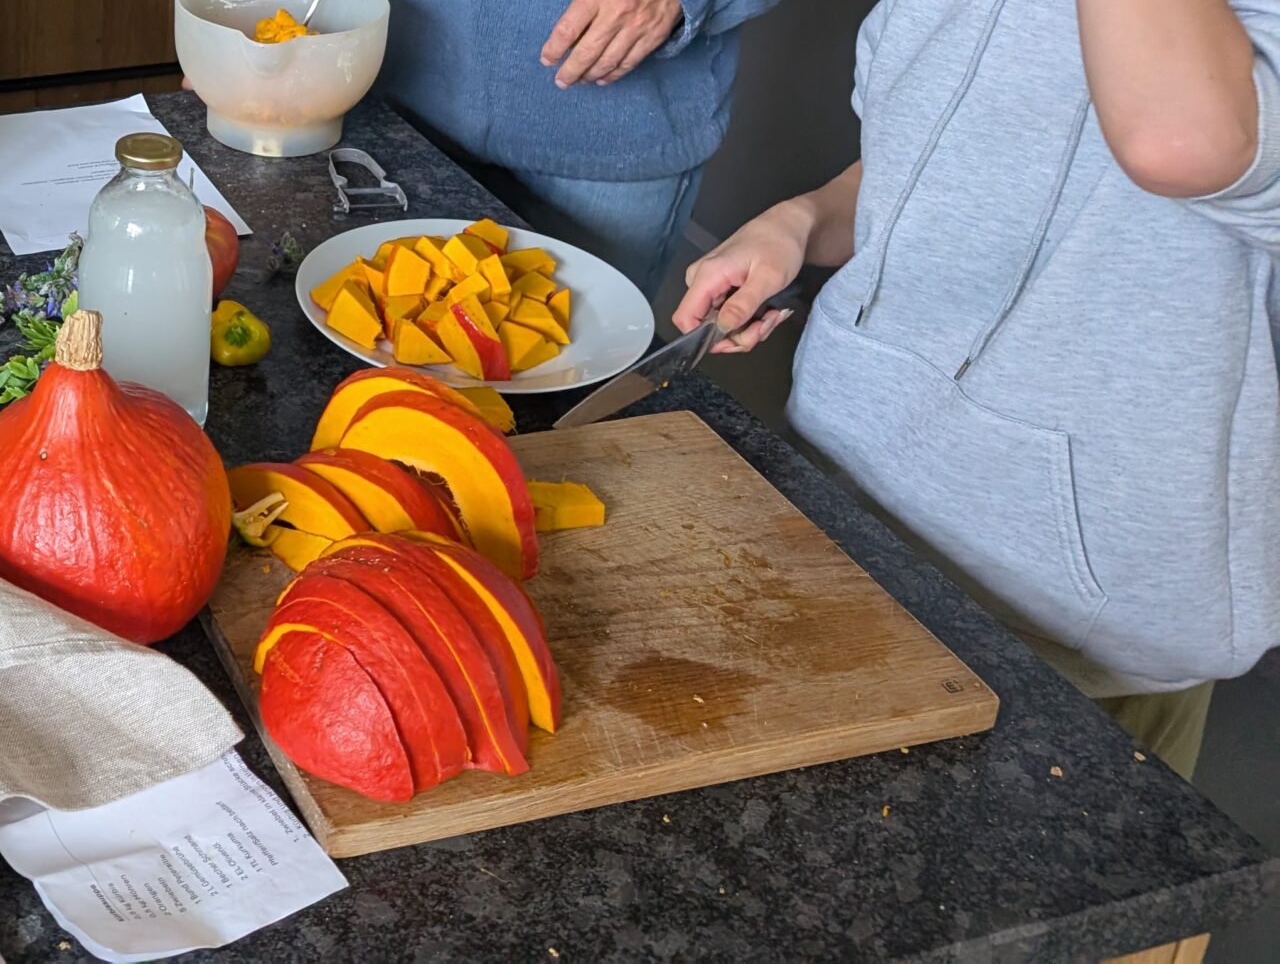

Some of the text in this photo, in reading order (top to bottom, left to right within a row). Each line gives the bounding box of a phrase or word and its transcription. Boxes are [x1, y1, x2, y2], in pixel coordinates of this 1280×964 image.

[232, 772, 252, 791] Stücke
[215, 801, 236, 817] bedarf
[264, 802, 273, 810] in
[233, 815, 249, 831] nach
[268, 809, 294, 835] Zwiebel
[183, 834, 212, 863] Schmand
[212, 842, 237, 867] Olivenöl
[227, 832, 253, 860] Kurkuma
[160, 854, 185, 885] Petersilie
[172, 846, 210, 887] Gemüsebrühe
[208, 859, 230, 884] Becher
[234, 865, 245, 876] EL
[90, 884, 125, 922] Kürbissuppe
[108, 882, 126, 904] Kürbis
[144, 882, 168, 914] Orangen
[158, 877, 183, 908] Zwiebeln
[181, 883, 199, 901] Bund
